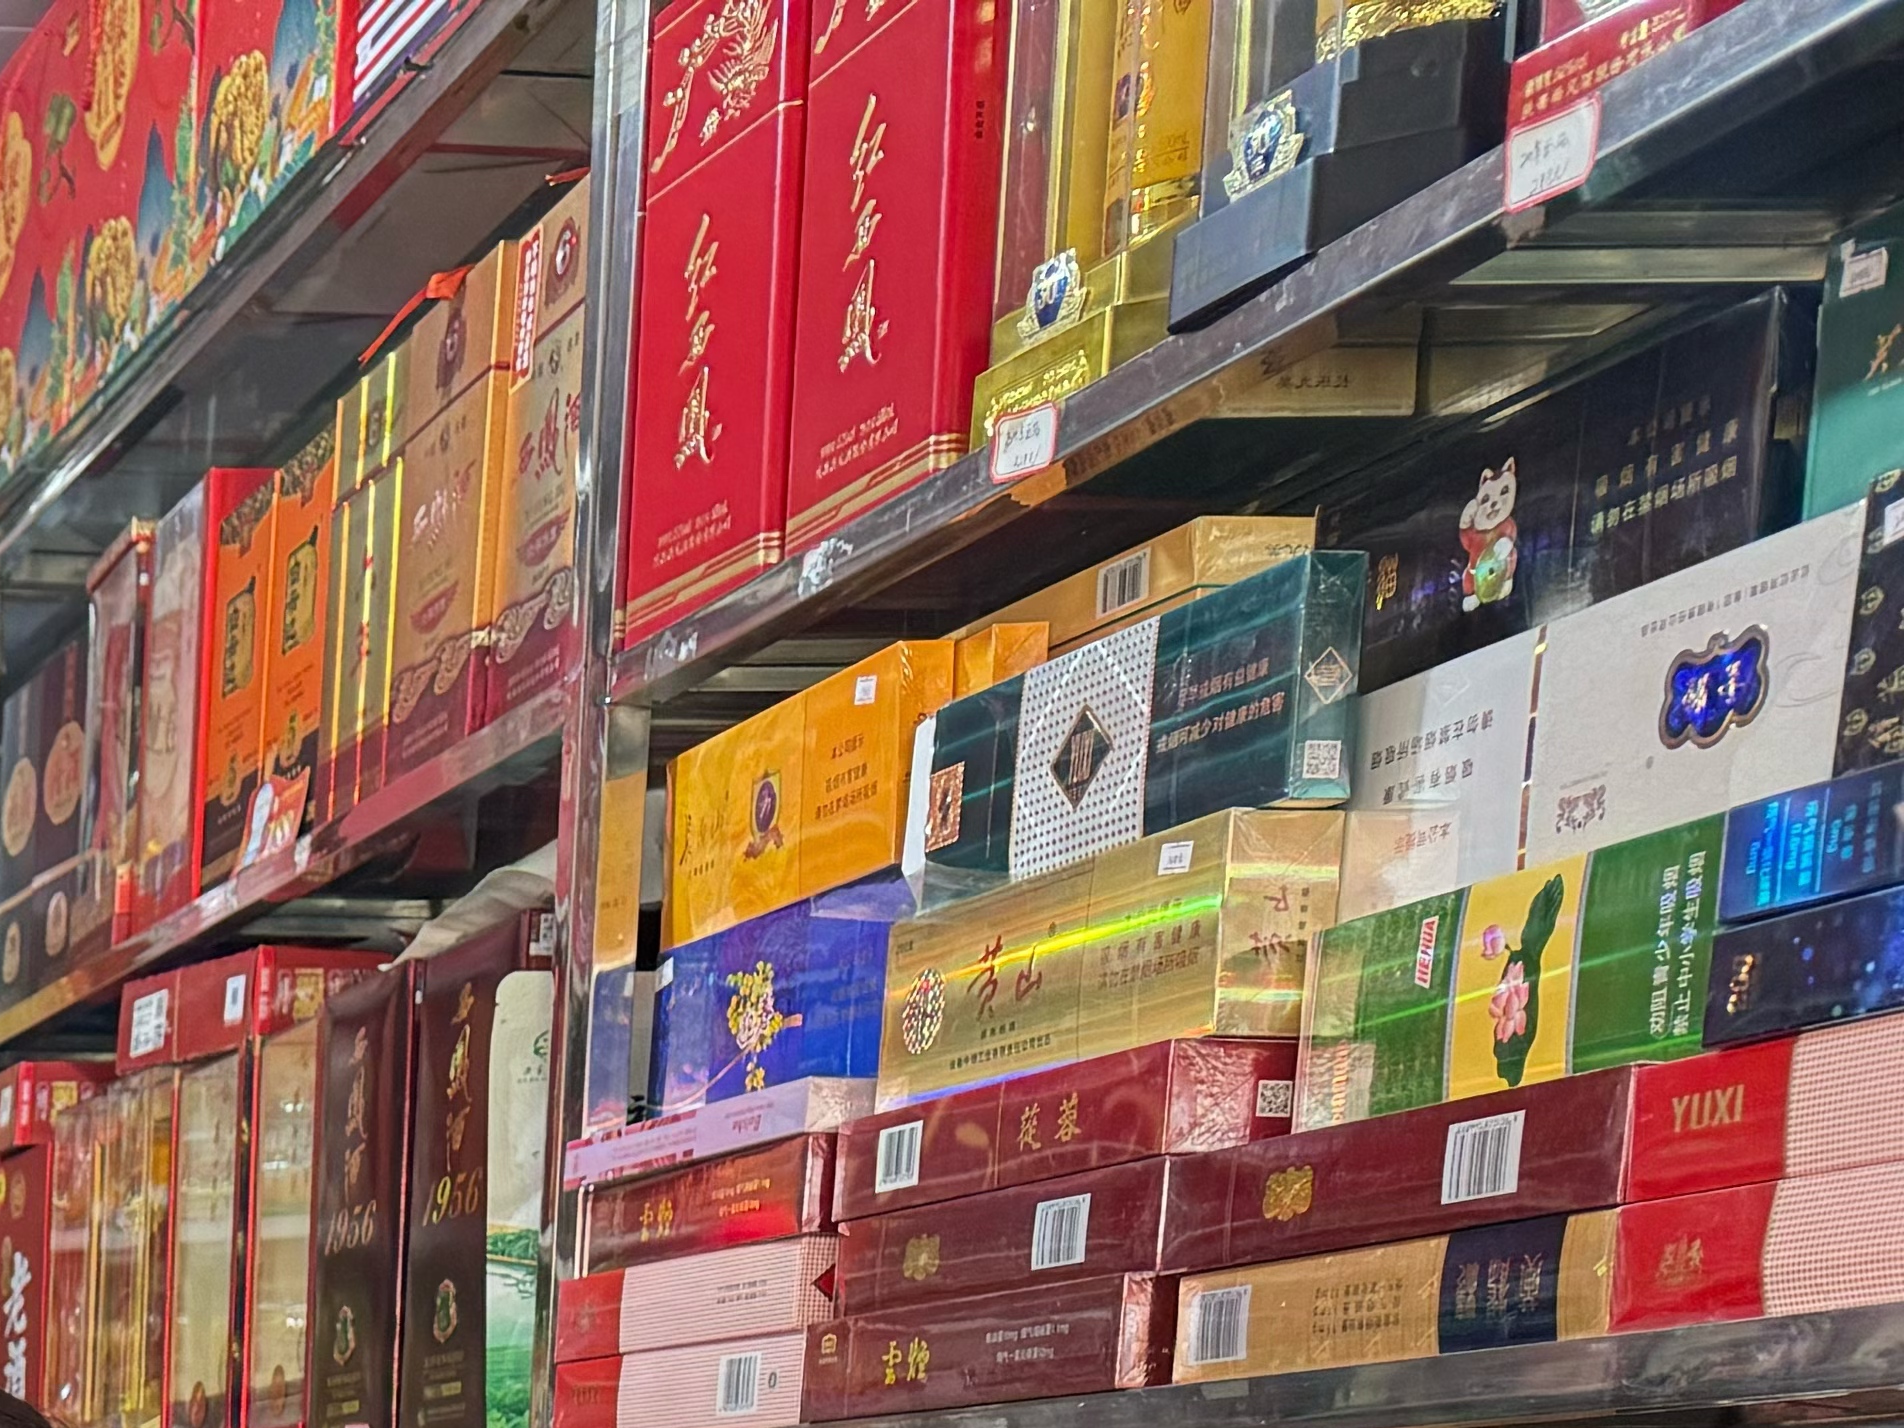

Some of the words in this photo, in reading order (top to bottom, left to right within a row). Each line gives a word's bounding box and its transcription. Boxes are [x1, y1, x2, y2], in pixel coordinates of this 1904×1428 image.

[1650, 866, 1682, 1037] 劝阻青少年吸烟
[1672, 852, 1703, 1037] 禁止中小学生吸烟
[1672, 1085, 1745, 1134] YUXI
[324, 1199, 376, 1256] 1956
[421, 1174, 484, 1227] 1956
